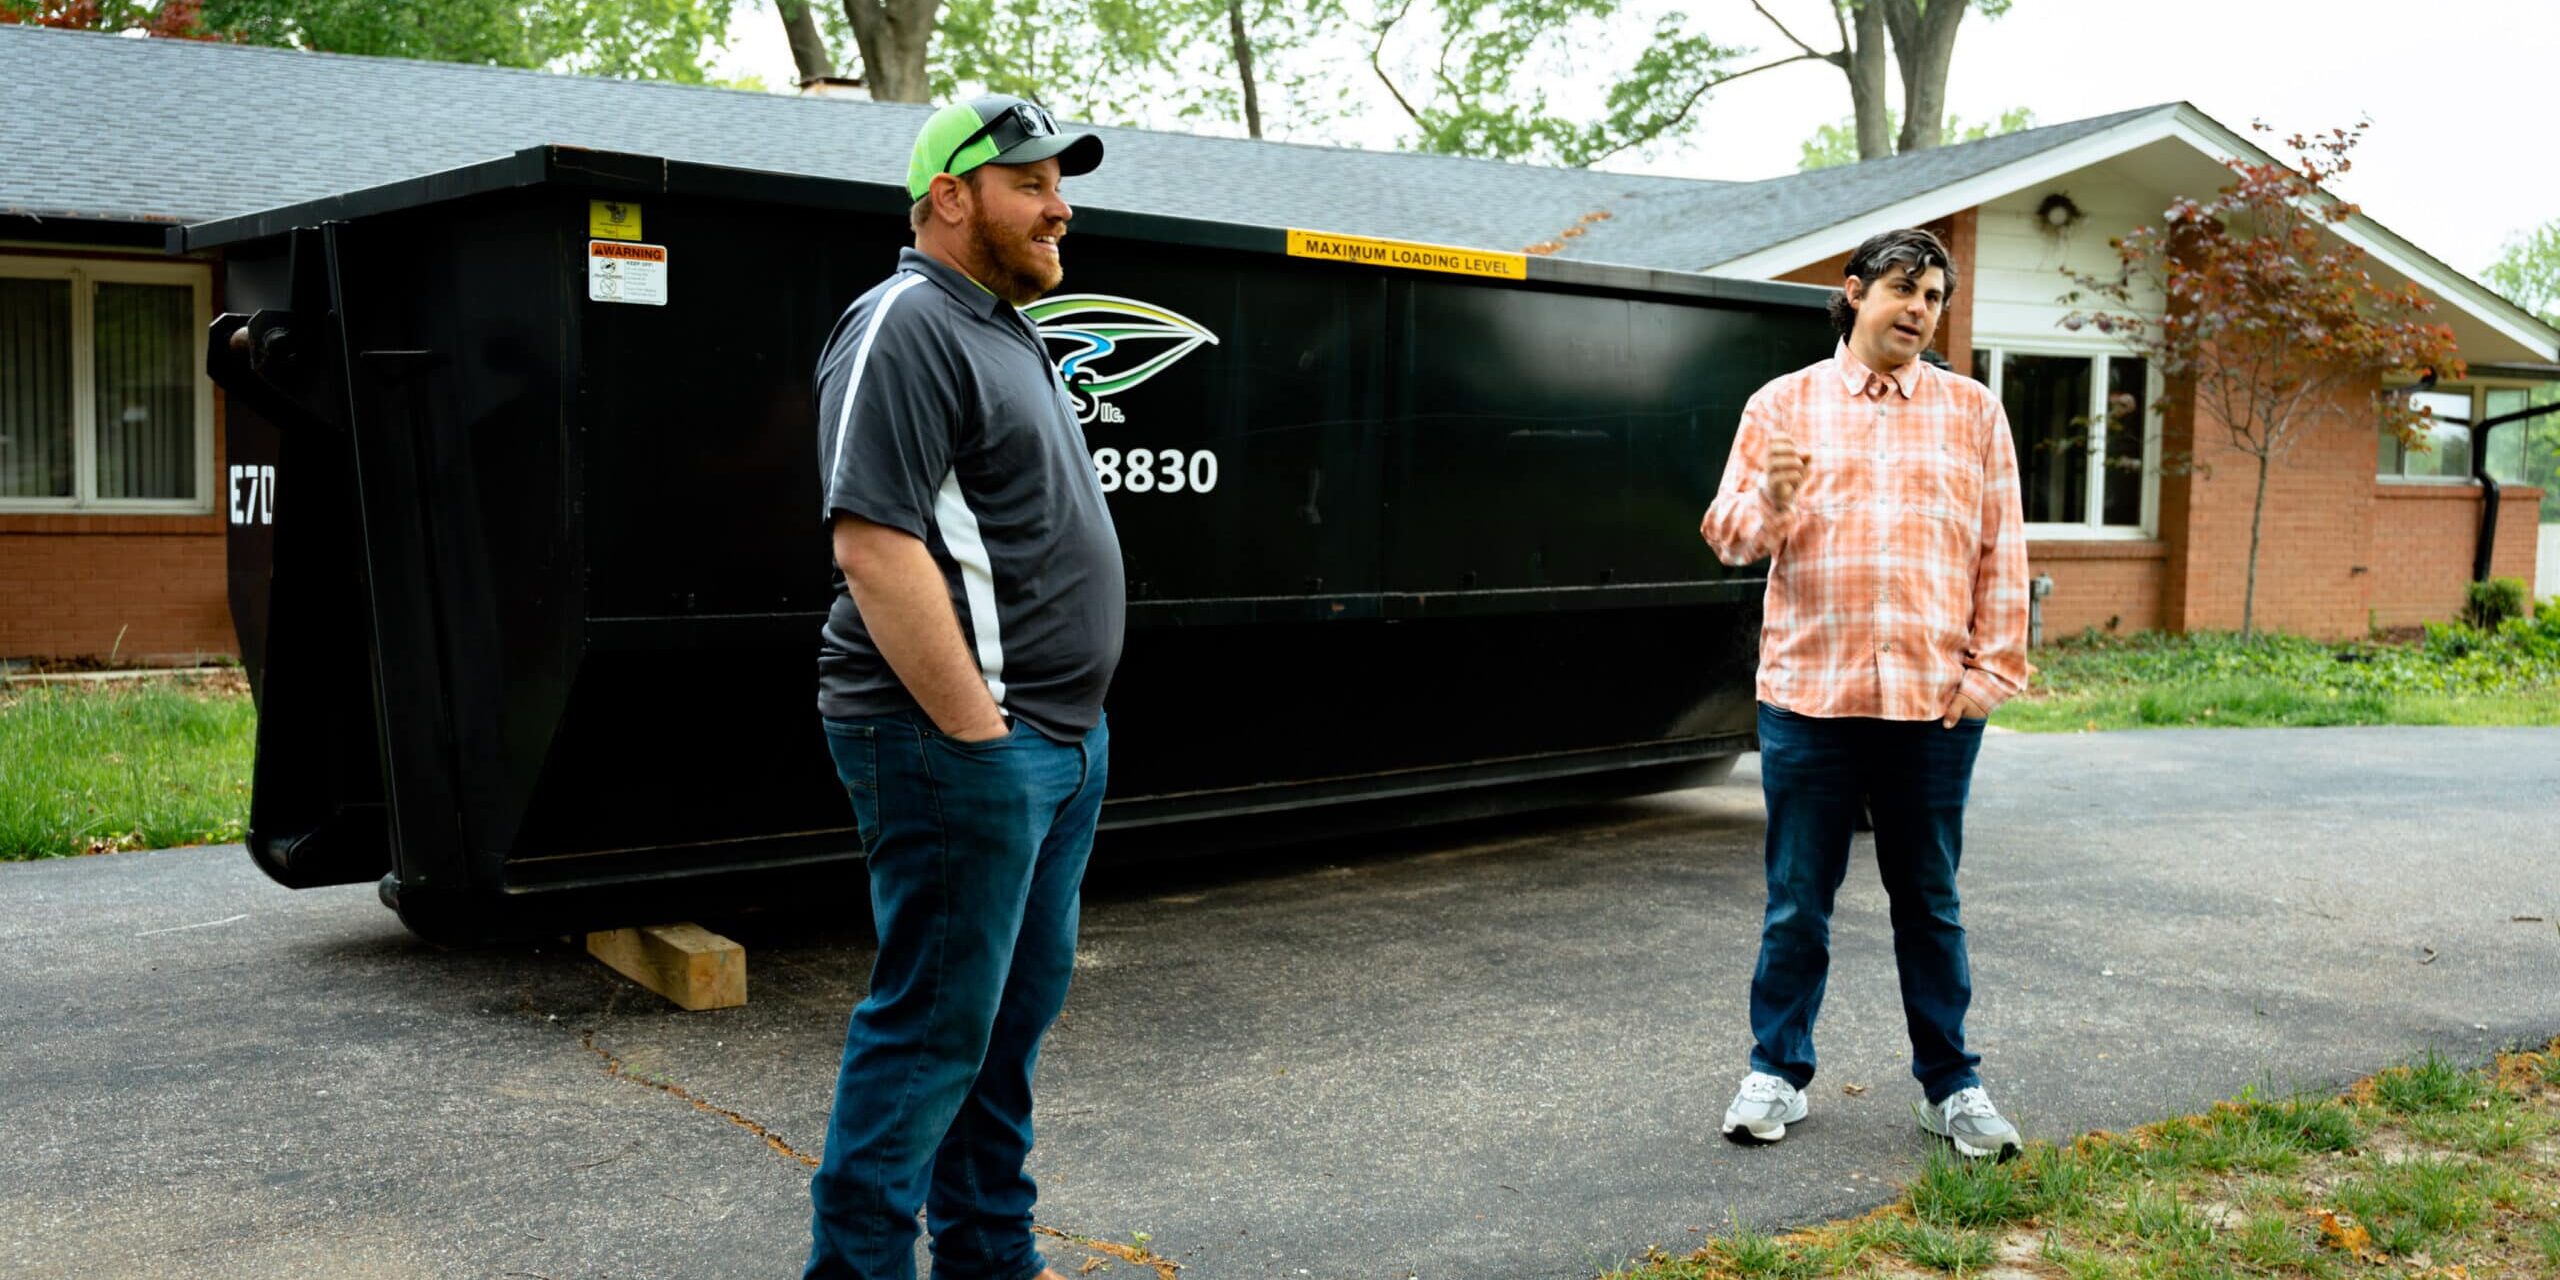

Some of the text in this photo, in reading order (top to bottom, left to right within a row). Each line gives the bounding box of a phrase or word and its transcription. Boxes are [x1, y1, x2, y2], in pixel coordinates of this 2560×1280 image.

[603, 245, 662, 260] WARNING
[1305, 240, 1511, 274] MAXIMUM LOADING LEVEL
